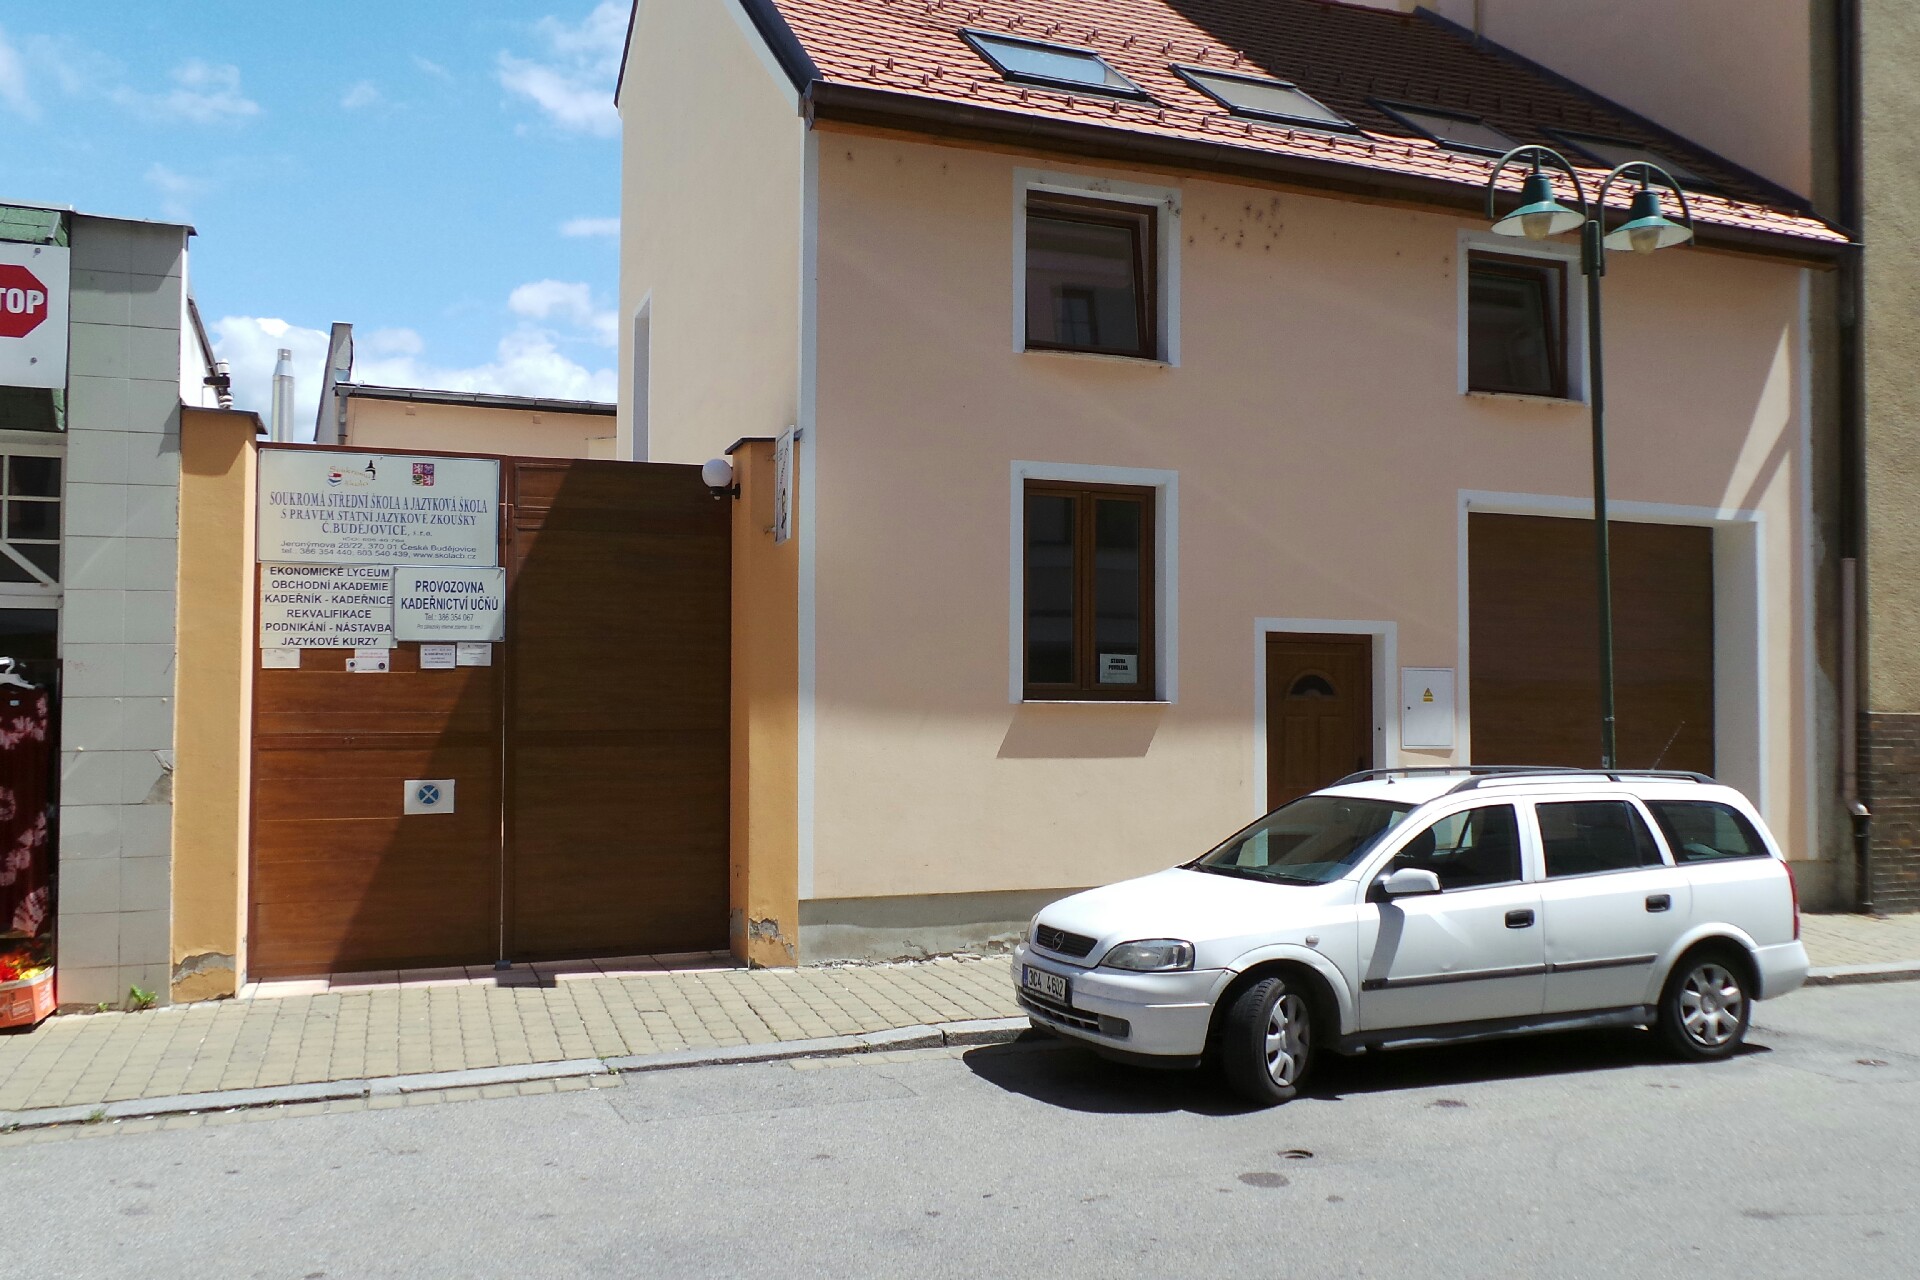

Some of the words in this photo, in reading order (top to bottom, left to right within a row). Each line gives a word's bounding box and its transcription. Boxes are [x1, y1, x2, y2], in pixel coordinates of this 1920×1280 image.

[269, 491, 325, 507] SOUKROMÁ
[327, 491, 368, 508] STŘEDNÍ
[370, 493, 401, 510] ŠKOLA
[403, 497, 409, 510] A
[410, 496, 457, 511] JAZYKOVÁ
[458, 496, 488, 514] ŠKOLA
[280, 508, 287, 519] S
[430, 513, 477, 526] ZKOUŠKY
[280, 541, 336, 549] Jeronýmova
[430, 544, 477, 553] Budějovice
[269, 566, 344, 577] EKONOMICKÉ
[347, 568, 390, 577] LYCEUM
[271, 580, 331, 590] OBCHODNÍ
[333, 582, 389, 591] AKADEMIE
[415, 580, 485, 593] PROVOZOVNA
[264, 593, 322, 604] KADEŘNÍK
[331, 594, 394, 605] KADEŘNICE
[401, 595, 468, 610] KADEŘNICTVÍ
[470, 595, 499, 611] UČŇŮ
[286, 609, 372, 618] REKVALIFIKACE
[450, 613, 461, 621] 354
[462, 613, 474, 621] 067
[265, 622, 326, 632] PODNIKÁNÍ
[335, 622, 393, 632] NÁSTAVBA
[281, 635, 339, 645] JAZYKOVÉ
[342, 637, 379, 645] KURZY
